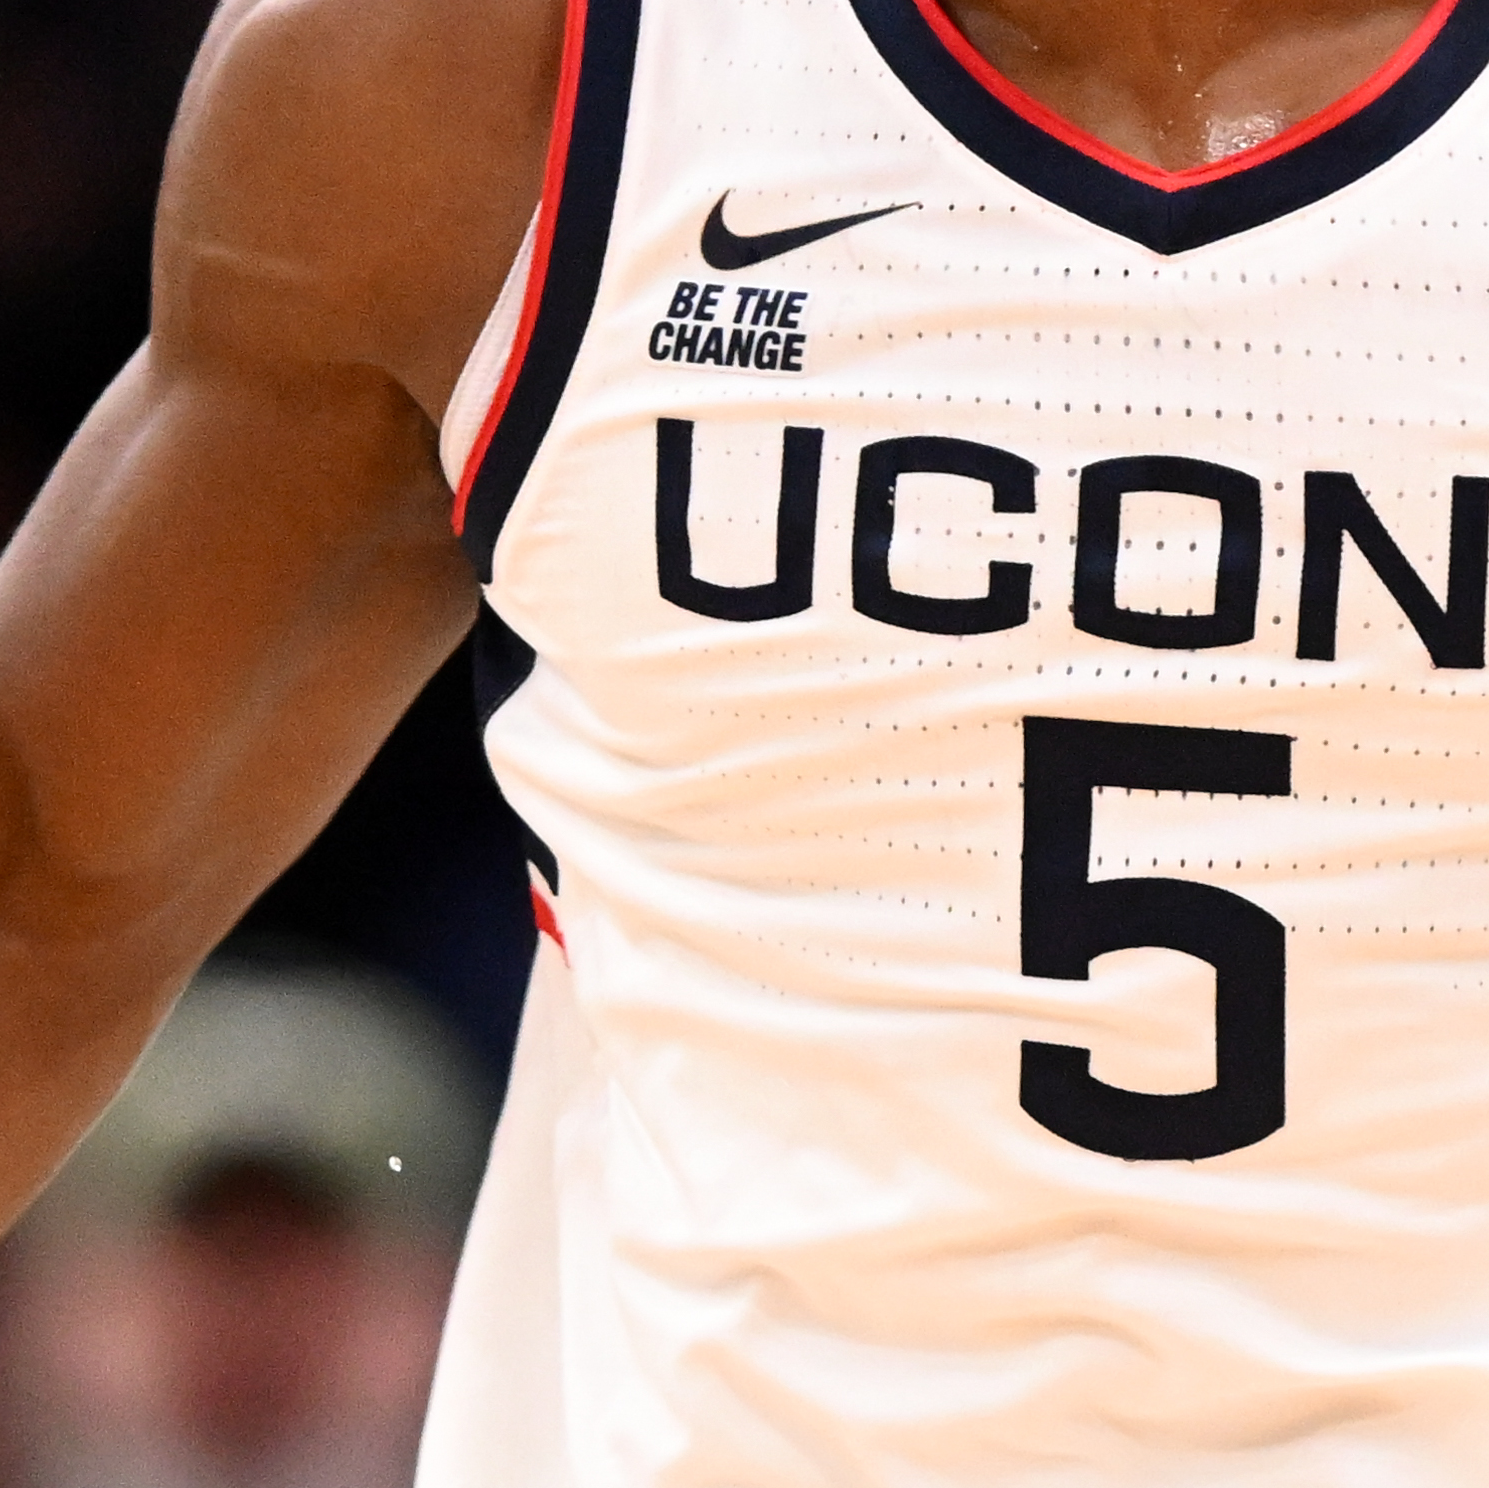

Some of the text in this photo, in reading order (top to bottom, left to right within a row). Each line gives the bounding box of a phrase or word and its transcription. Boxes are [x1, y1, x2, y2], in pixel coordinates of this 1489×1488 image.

[666, 280, 809, 329] BE THE
[647, 320, 808, 373] CHANGE
[1017, 714, 1298, 1163] 5
